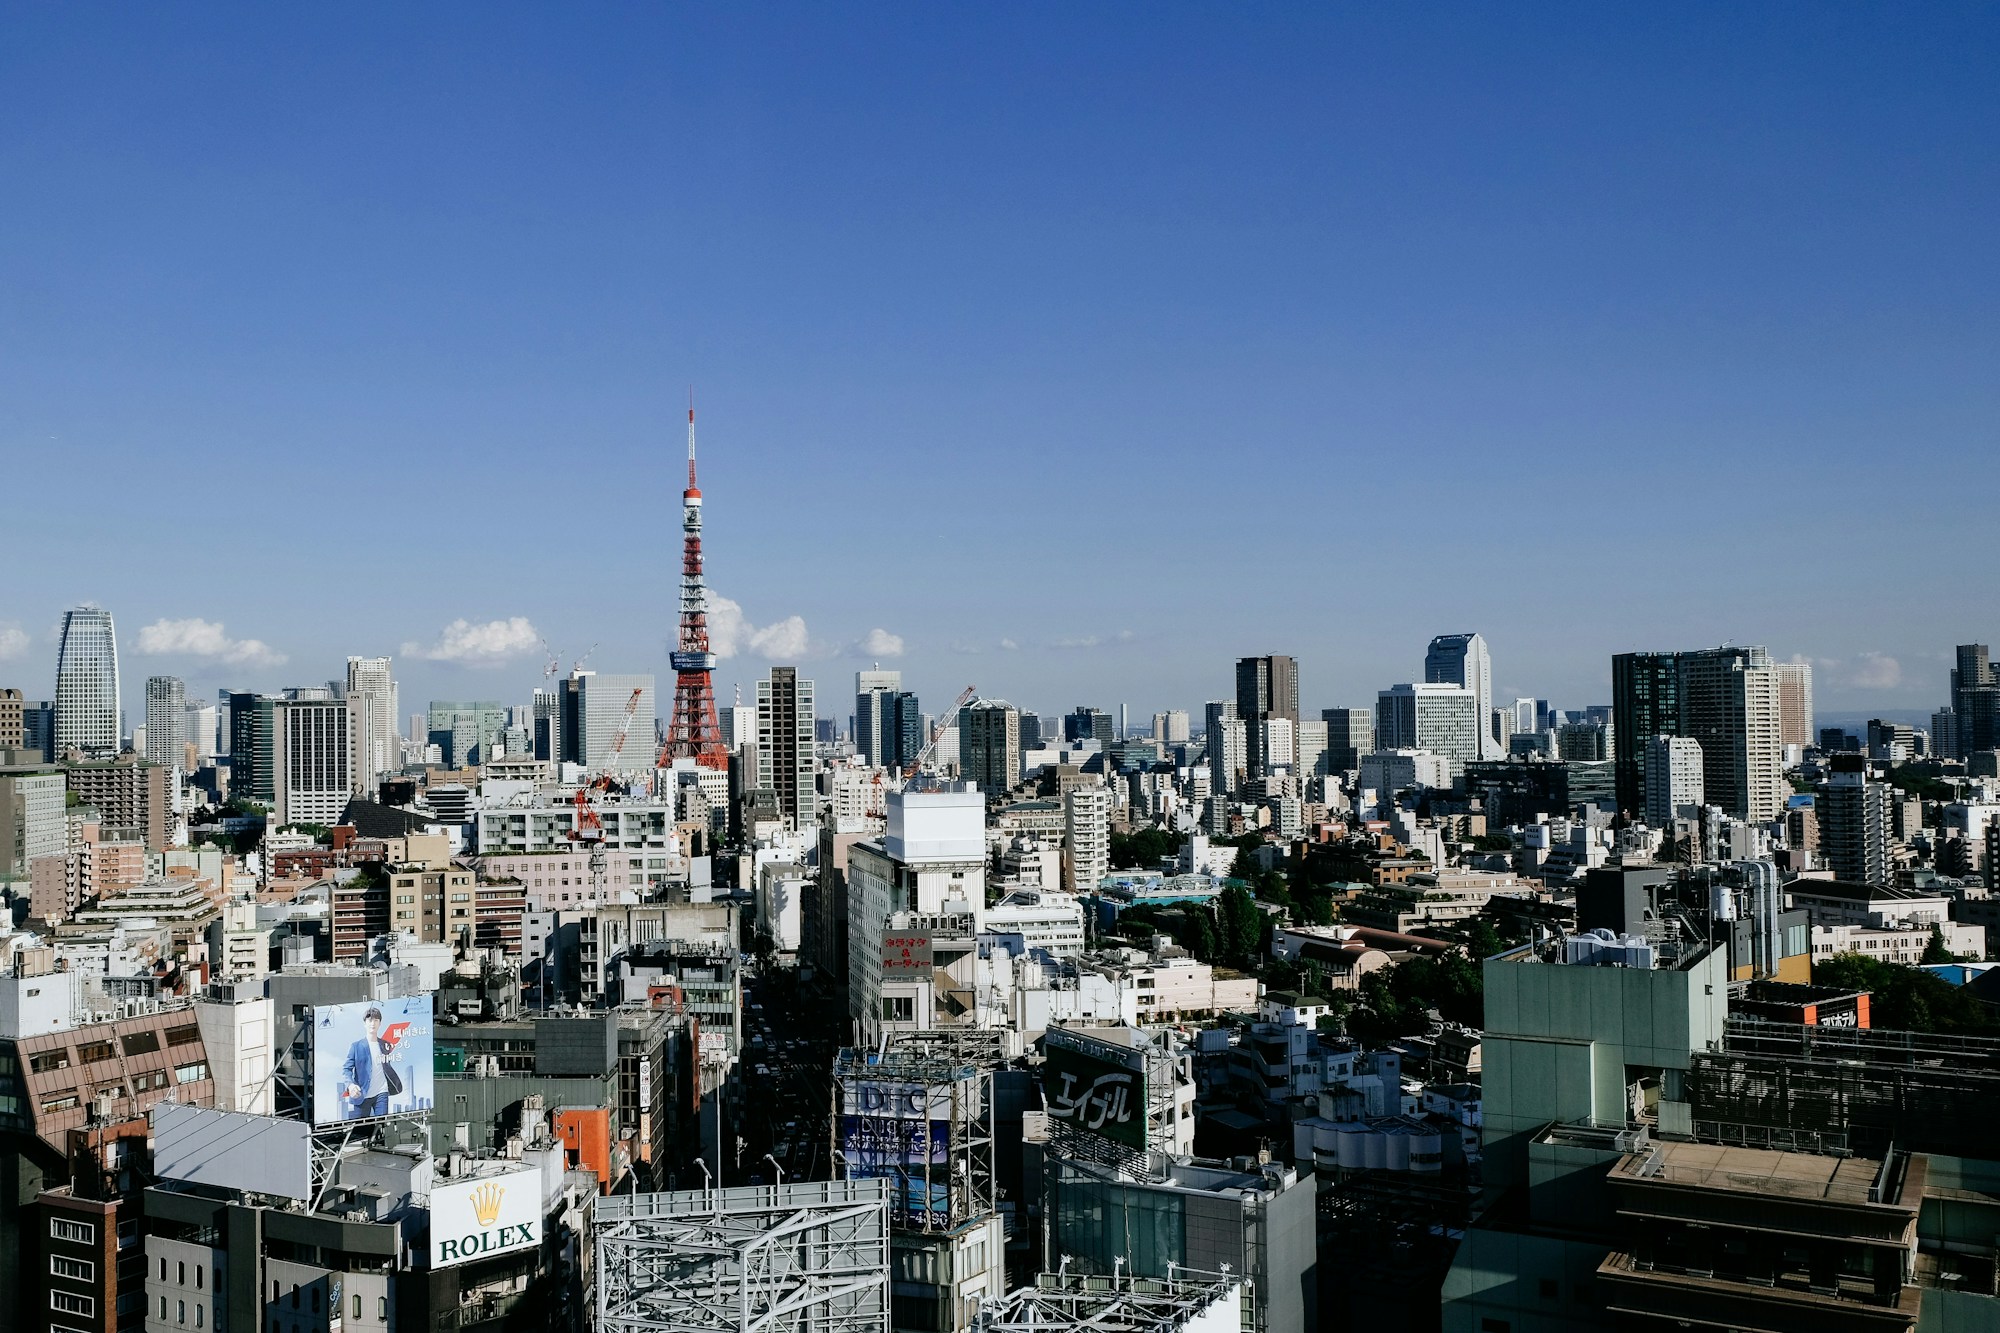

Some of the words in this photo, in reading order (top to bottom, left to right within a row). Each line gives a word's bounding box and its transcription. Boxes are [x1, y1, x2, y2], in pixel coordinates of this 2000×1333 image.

[885, 938, 927, 948] カラオケ
[902, 948, 911, 957] &
[883, 959, 930, 968] パーティー
[1821, 1011, 1856, 1027] アパホテル
[393, 1026, 430, 1039] 風向きは、
[385, 1041, 410, 1051] いつも
[378, 1053, 403, 1063] 前向き
[866, 1087, 927, 1112] DHC
[1047, 1072, 1133, 1129] エイブル
[439, 1222, 536, 1262] ROLEX
